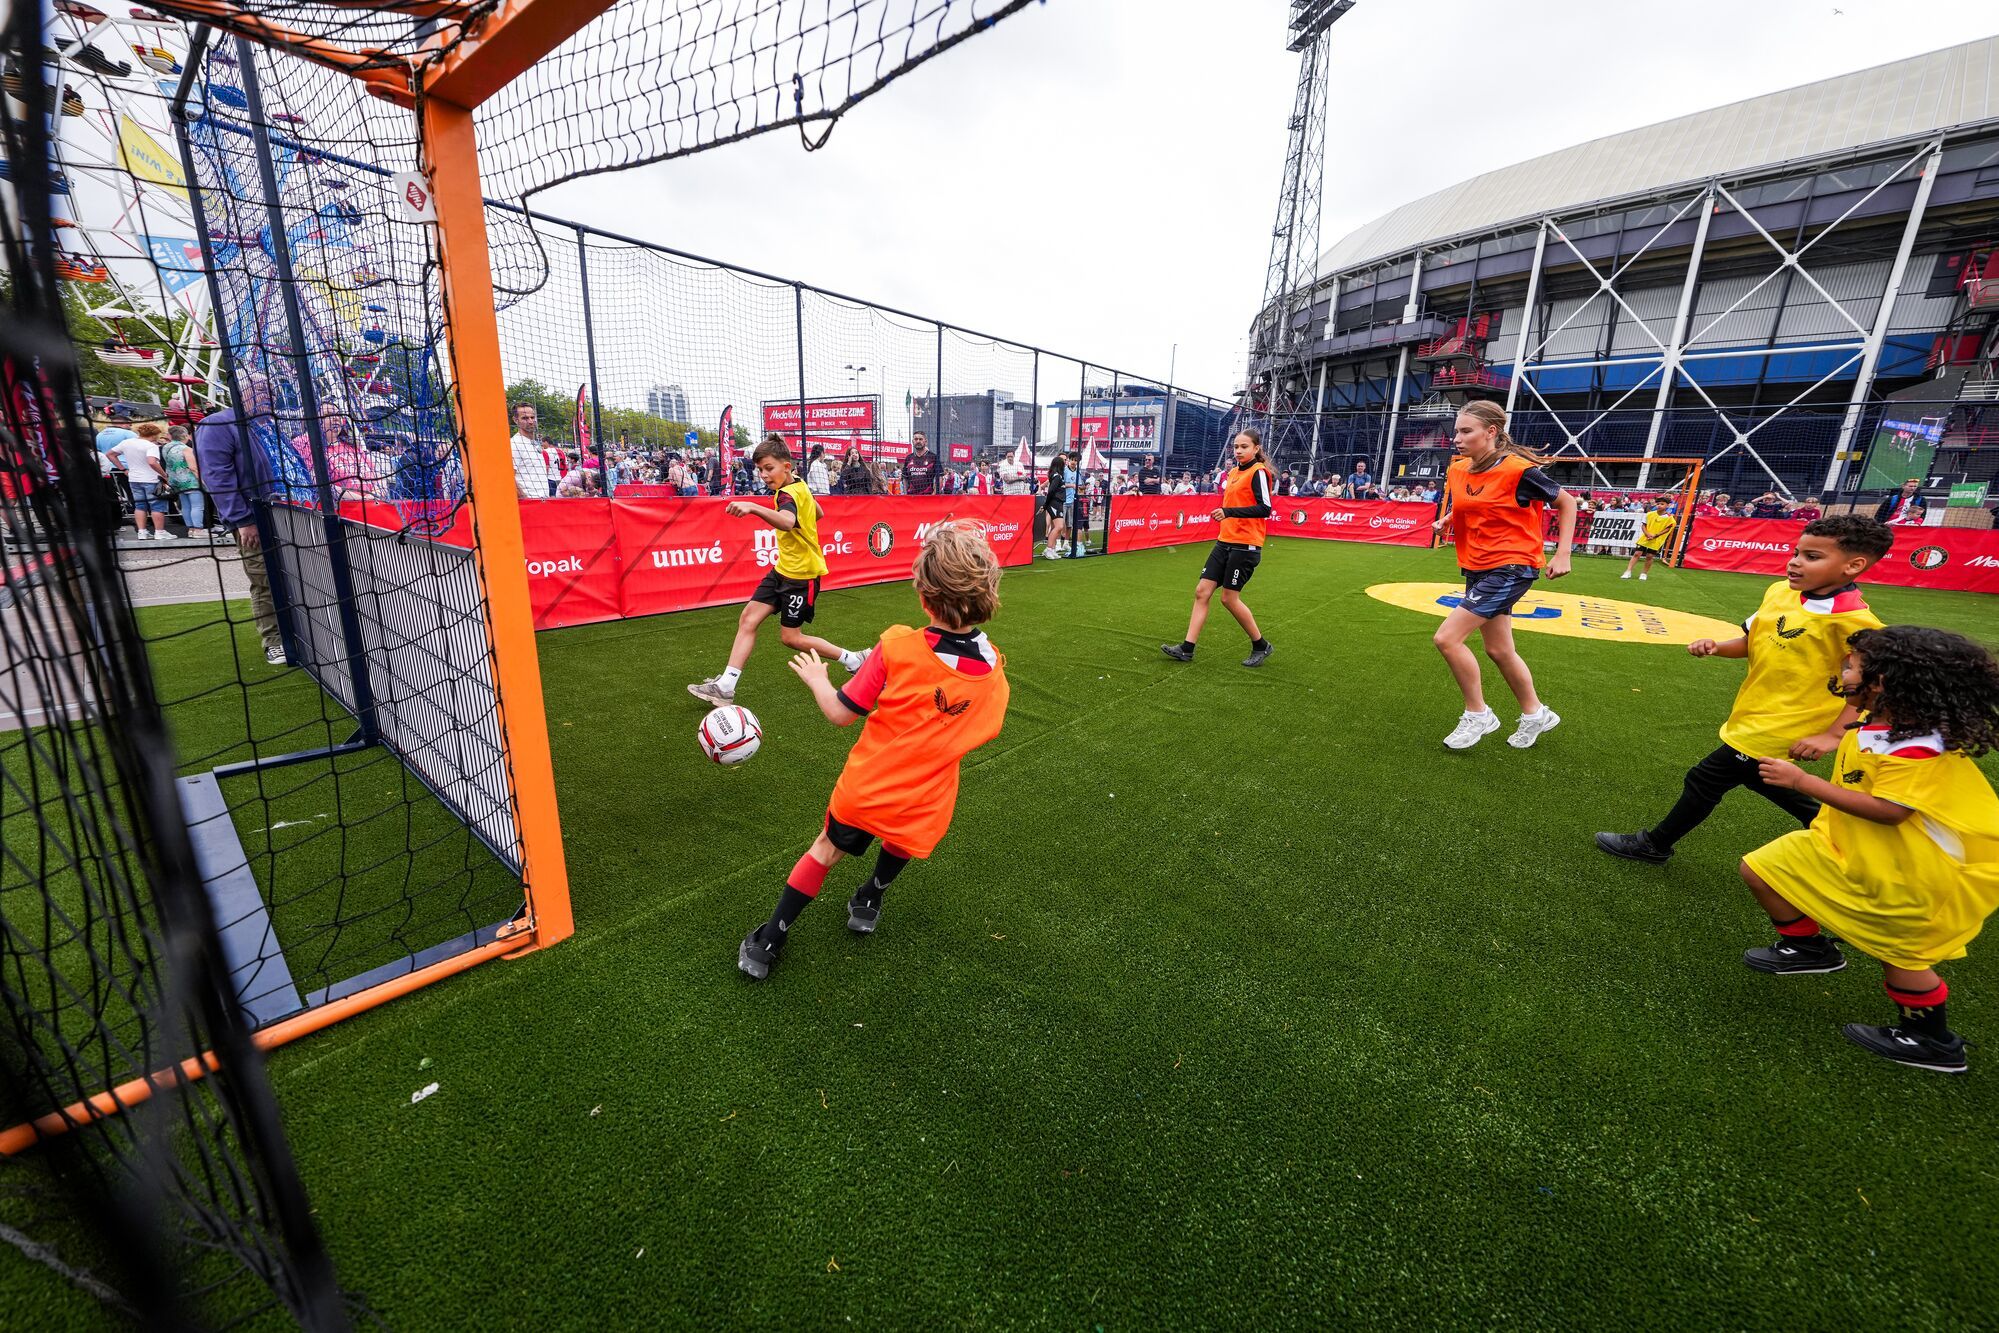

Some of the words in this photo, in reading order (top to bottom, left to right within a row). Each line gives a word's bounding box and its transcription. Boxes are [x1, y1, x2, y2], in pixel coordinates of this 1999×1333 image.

[848, 407, 866, 417] ZONE
[1321, 512, 1355, 522] MAAT
[1395, 517, 1417, 525] Ginkel
[1549, 516, 1635, 530] FENOORD
[986, 524, 998, 532] Van
[999, 523, 1019, 532] Ginkel
[1114, 518, 1145, 532] QTERMINALS
[993, 533, 1014, 541] GROEP
[1547, 526, 1636, 541] RTERDAM
[1702, 538, 1790, 552] QTERMINALS
[652, 540, 723, 568] univé
[524, 555, 584, 578] opak
[1233, 569, 1240, 579] 9
[788, 594, 804, 609] 29
